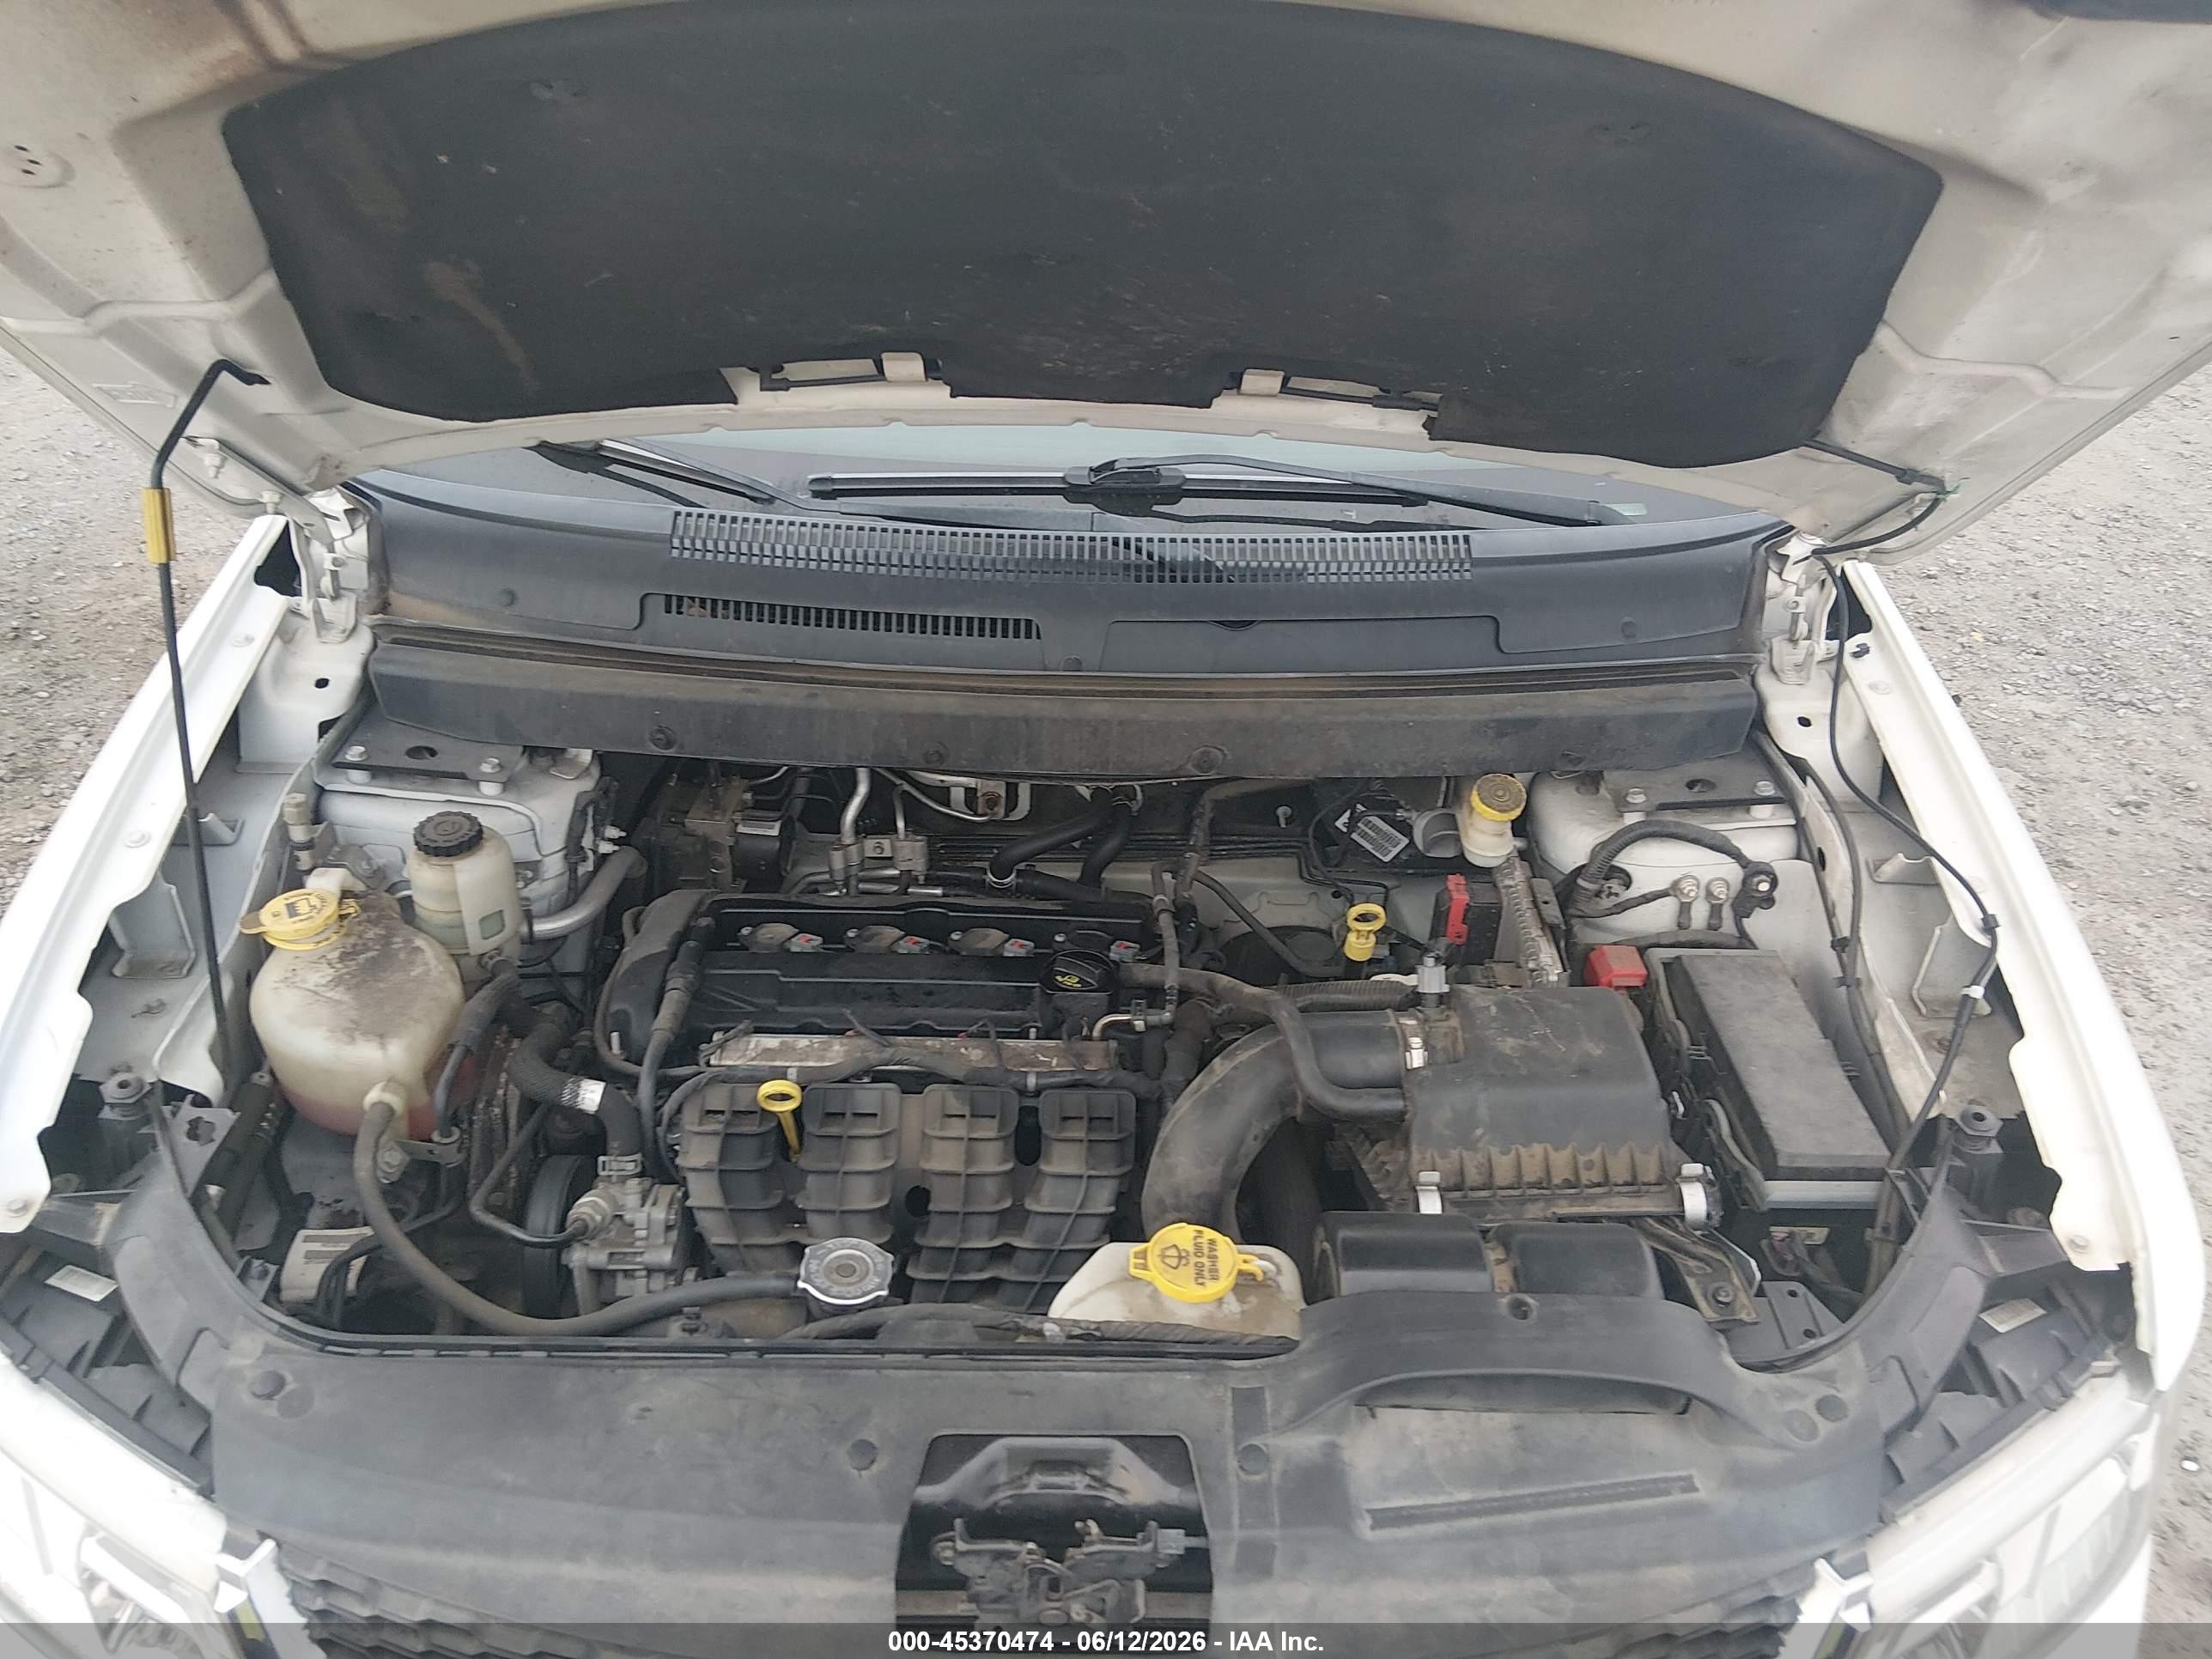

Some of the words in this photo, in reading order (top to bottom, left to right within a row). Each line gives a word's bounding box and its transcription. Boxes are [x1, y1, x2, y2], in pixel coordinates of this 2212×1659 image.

[1194, 1229, 1205, 1258] FLUID
[1194, 1261, 1207, 1286] ONLY
[1206, 1238, 1219, 1280] WASHER
